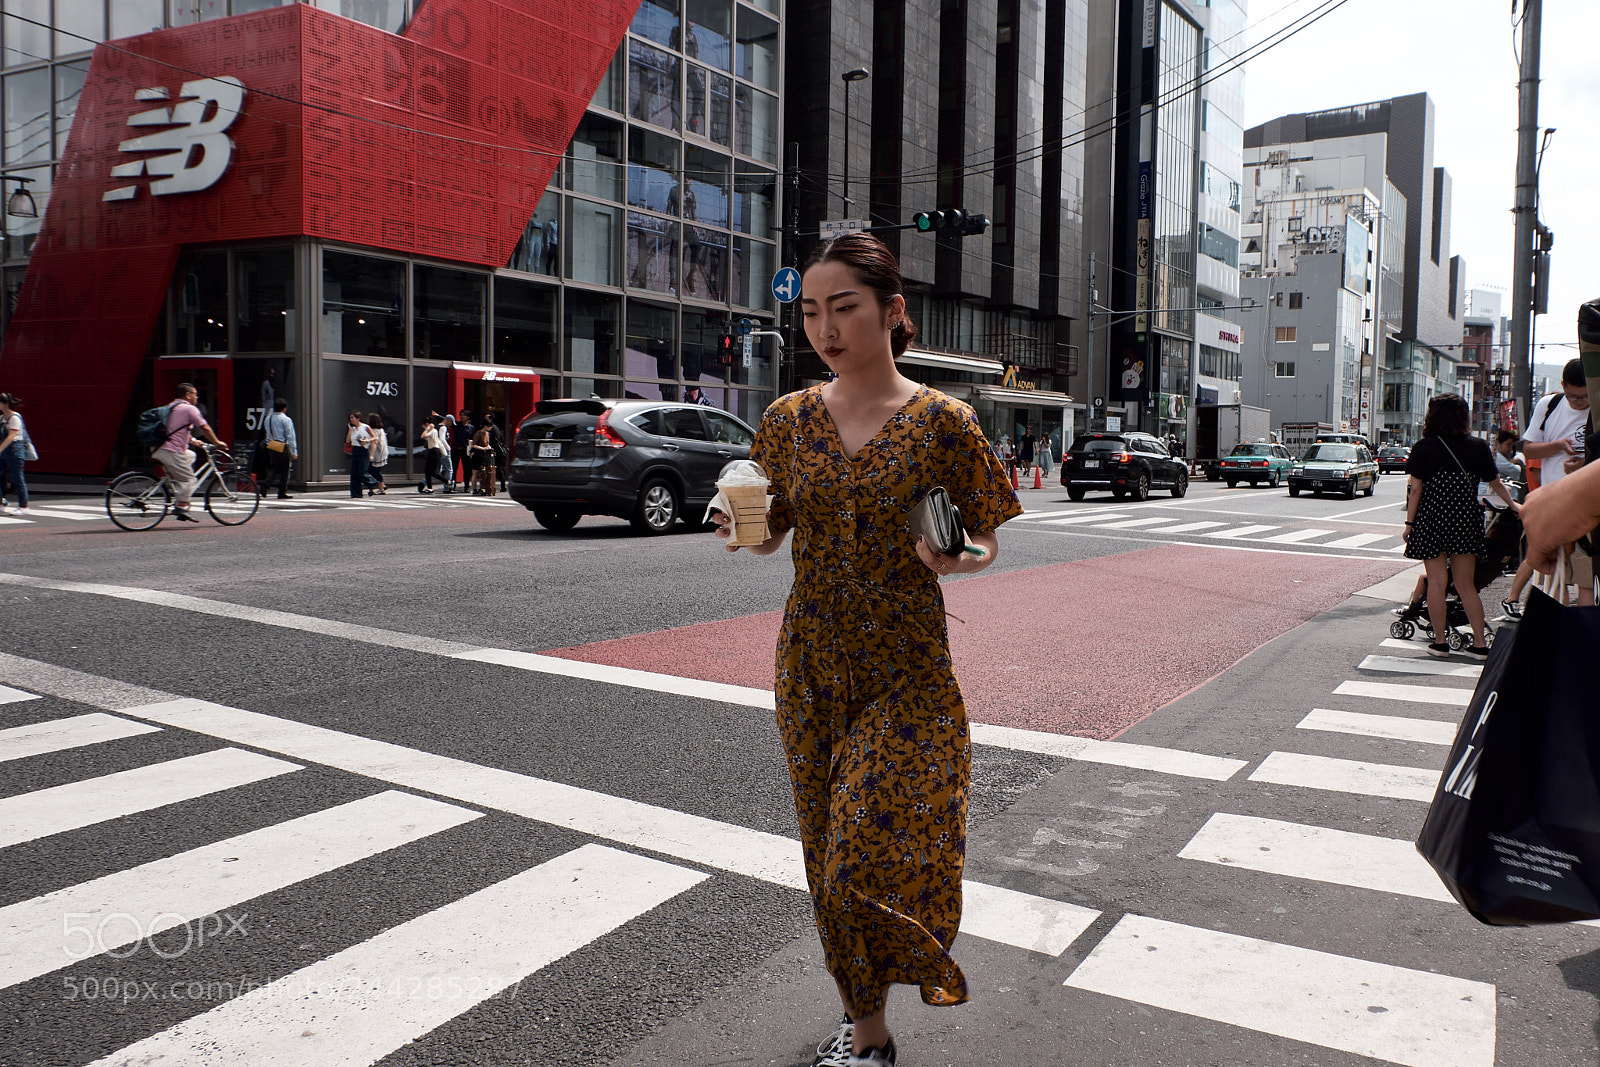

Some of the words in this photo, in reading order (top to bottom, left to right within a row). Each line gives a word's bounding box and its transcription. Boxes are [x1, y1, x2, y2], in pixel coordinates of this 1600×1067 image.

[1319, 197, 1346, 206] COSMO
[826, 221, 856, 232] 竹下口
[366, 380, 399, 397] 574S
